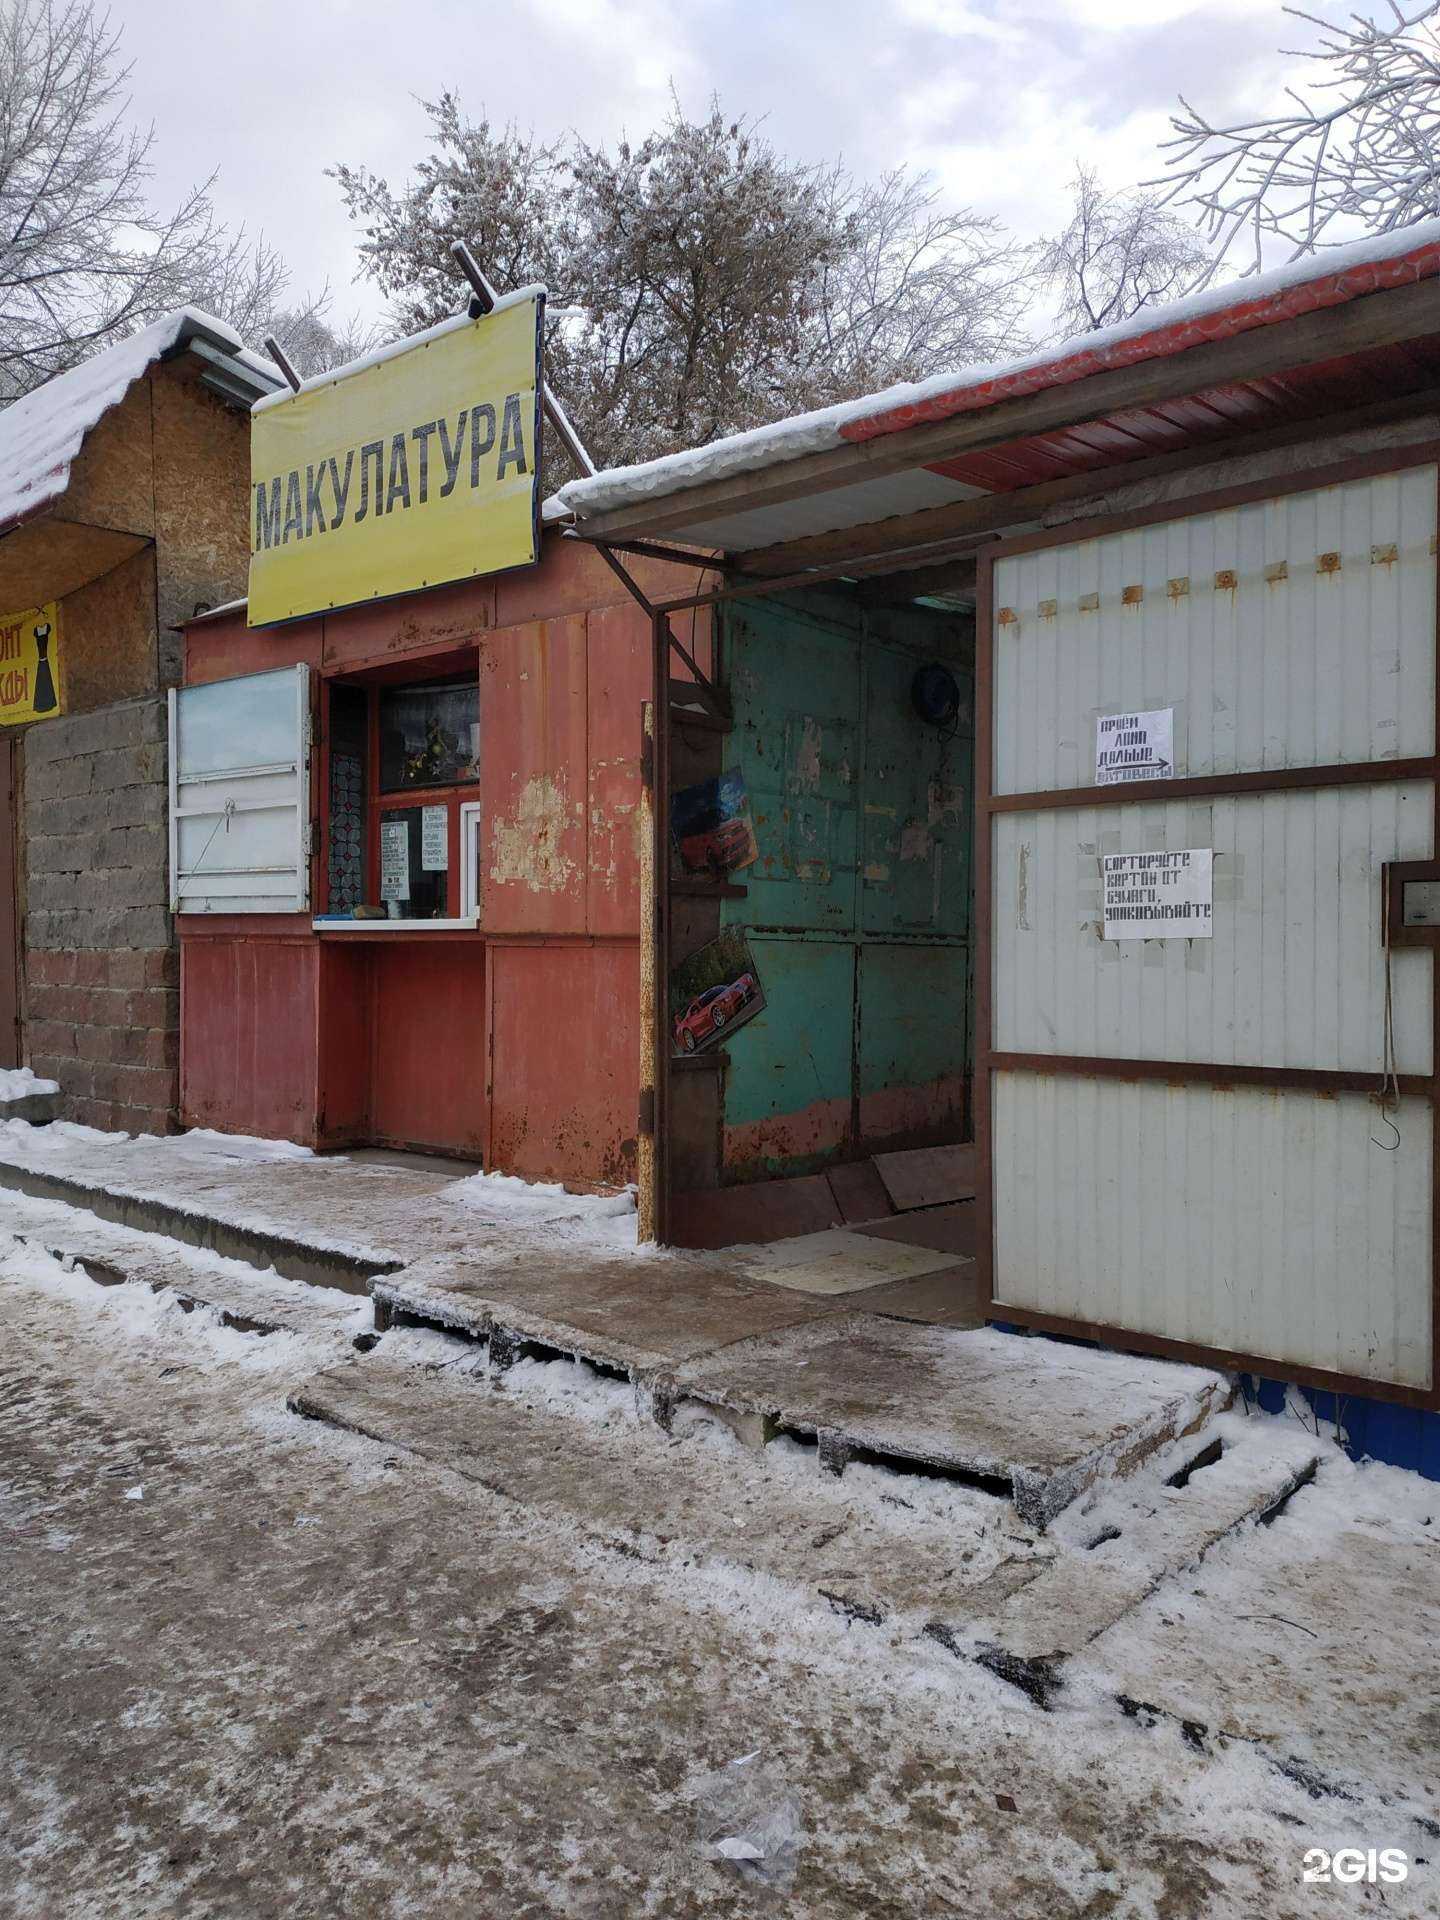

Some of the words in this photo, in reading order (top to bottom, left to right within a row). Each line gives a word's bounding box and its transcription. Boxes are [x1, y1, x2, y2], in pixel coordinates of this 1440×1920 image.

[255, 392, 527, 551] МАКУЛАТУРА
[0, 667, 28, 706] ДЫ
[1097, 747, 1153, 768] ДАЛЬШЕ
[1107, 871, 1157, 888] КАРТОН
[1162, 870, 1182, 885] ОТ
[1107, 889, 1162, 905] БУМАГИ,
[1105, 901, 1212, 921] УПАКОВЫВАЙТЕ
